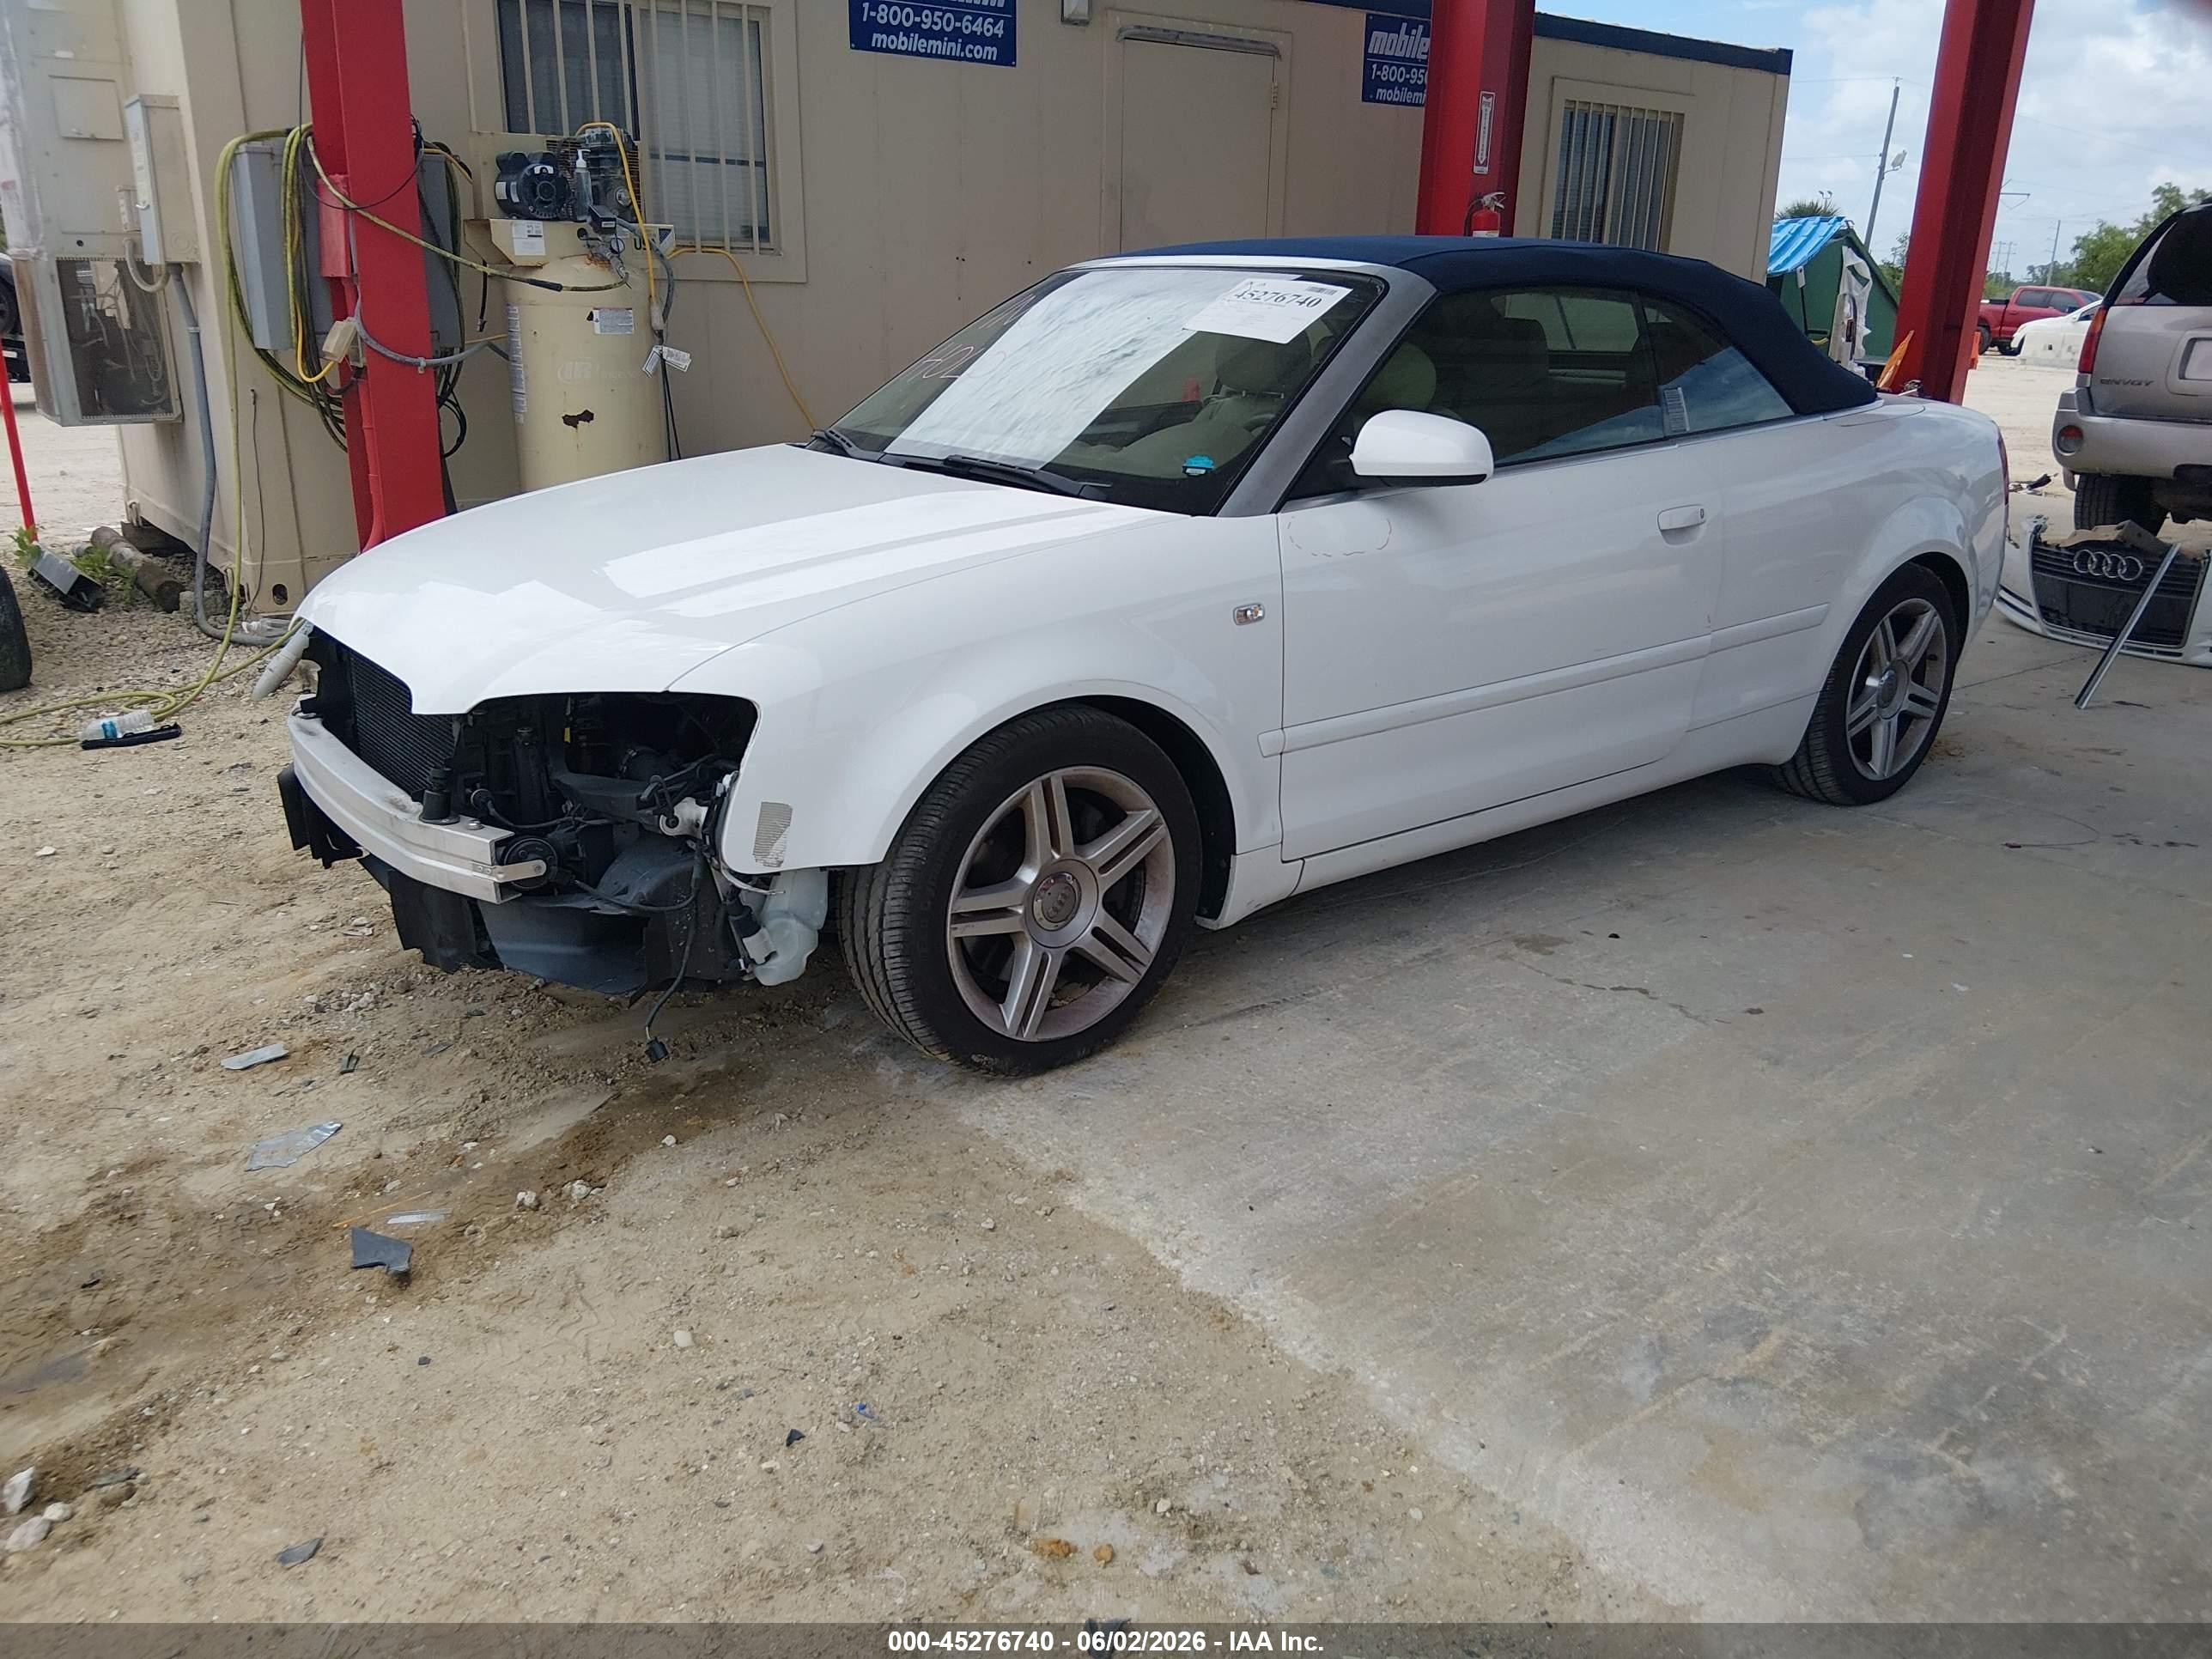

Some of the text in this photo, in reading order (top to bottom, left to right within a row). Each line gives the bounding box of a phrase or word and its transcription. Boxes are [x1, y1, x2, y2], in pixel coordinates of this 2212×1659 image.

[861, 2, 1005, 39] 1-800-950-6464
[871, 32, 998, 61] mobilemini.com
[1368, 22, 1430, 60] mobile
[1234, 290, 1322, 308] 45276740
